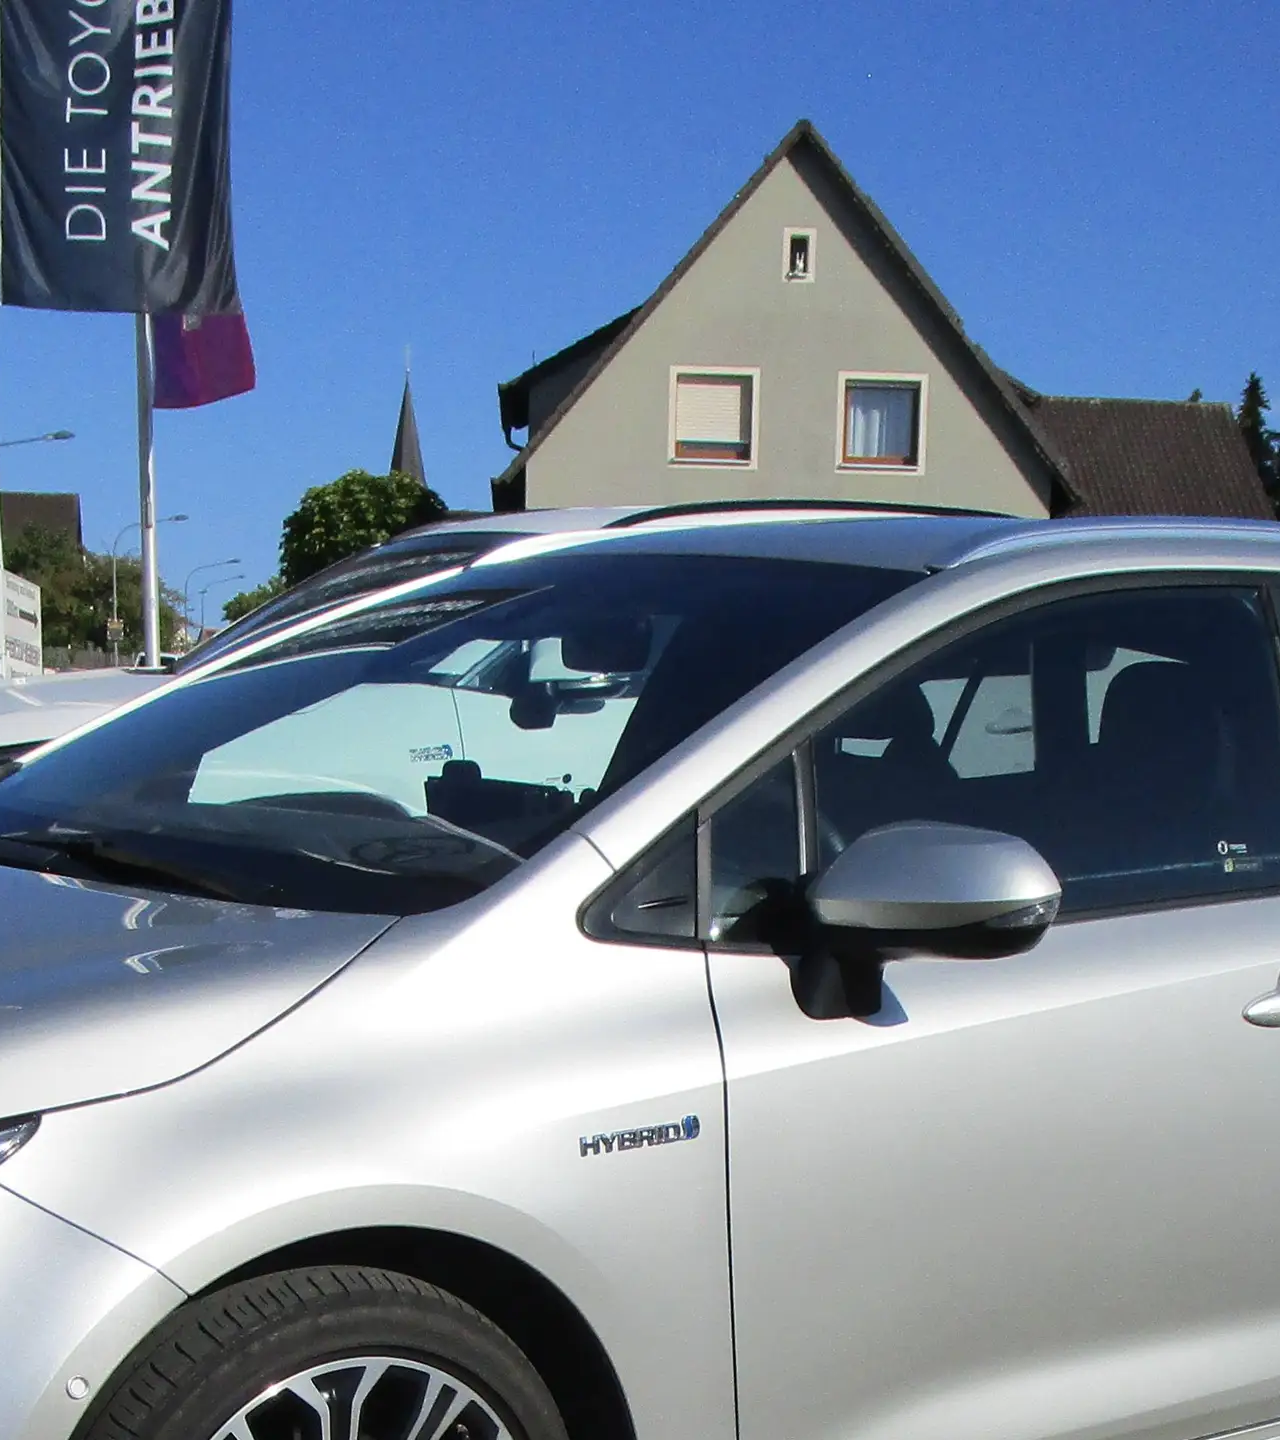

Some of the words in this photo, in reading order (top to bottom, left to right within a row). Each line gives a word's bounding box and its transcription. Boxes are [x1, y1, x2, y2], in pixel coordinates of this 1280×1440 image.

[66, 0, 112, 124] TOY
[131, 0, 175, 251] ANTRIEB
[64, 147, 107, 241] DIE
[579, 1122, 681, 1157] HYBRID
